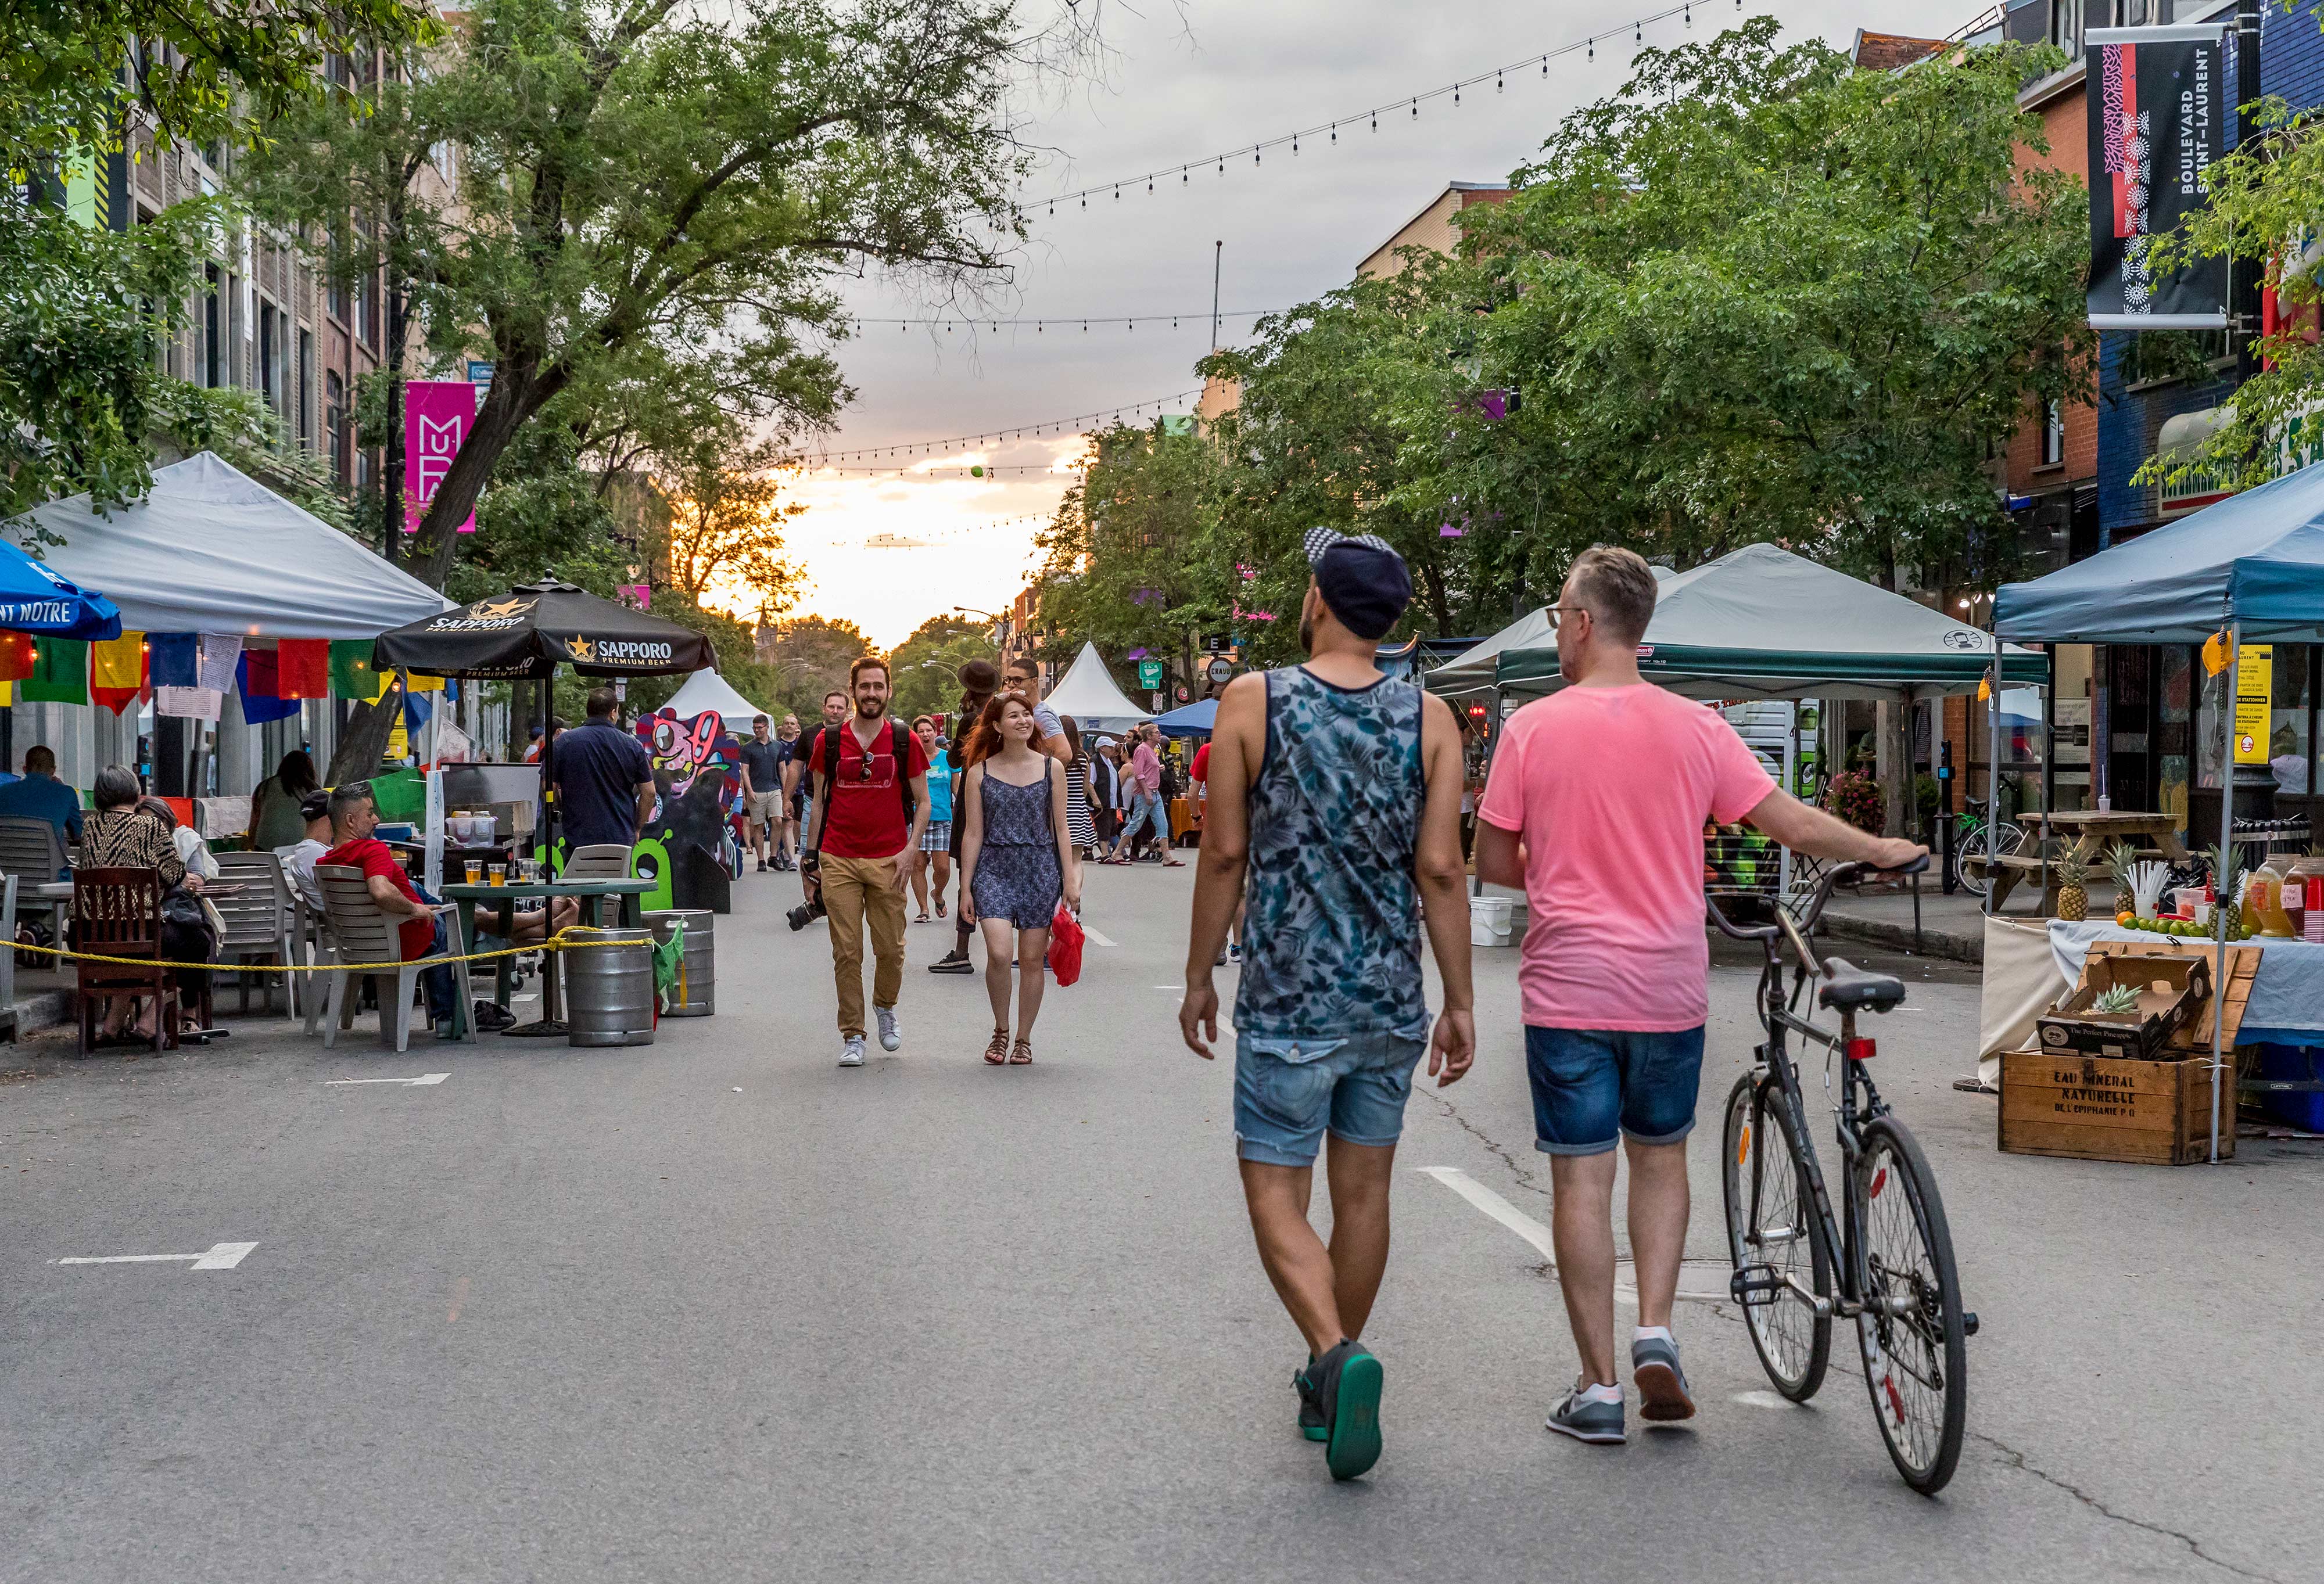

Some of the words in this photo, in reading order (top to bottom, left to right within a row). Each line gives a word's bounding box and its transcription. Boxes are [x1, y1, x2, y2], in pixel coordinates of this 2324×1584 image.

[2181, 90, 2194, 194] BOULEVARD
[20, 602, 70, 622] NOTRE
[429, 616, 525, 628] SAPPORO
[598, 641, 672, 659] SAPPORO
[602, 657, 647, 665] PREMIUM
[2083, 1028, 2102, 1036] Perfect
[2104, 1030, 2132, 1039] Pineapple
[2054, 1072, 2077, 1083] EAU
[2062, 1088, 2135, 1104] NATURELLE
[2054, 1104, 2064, 1112] DE
